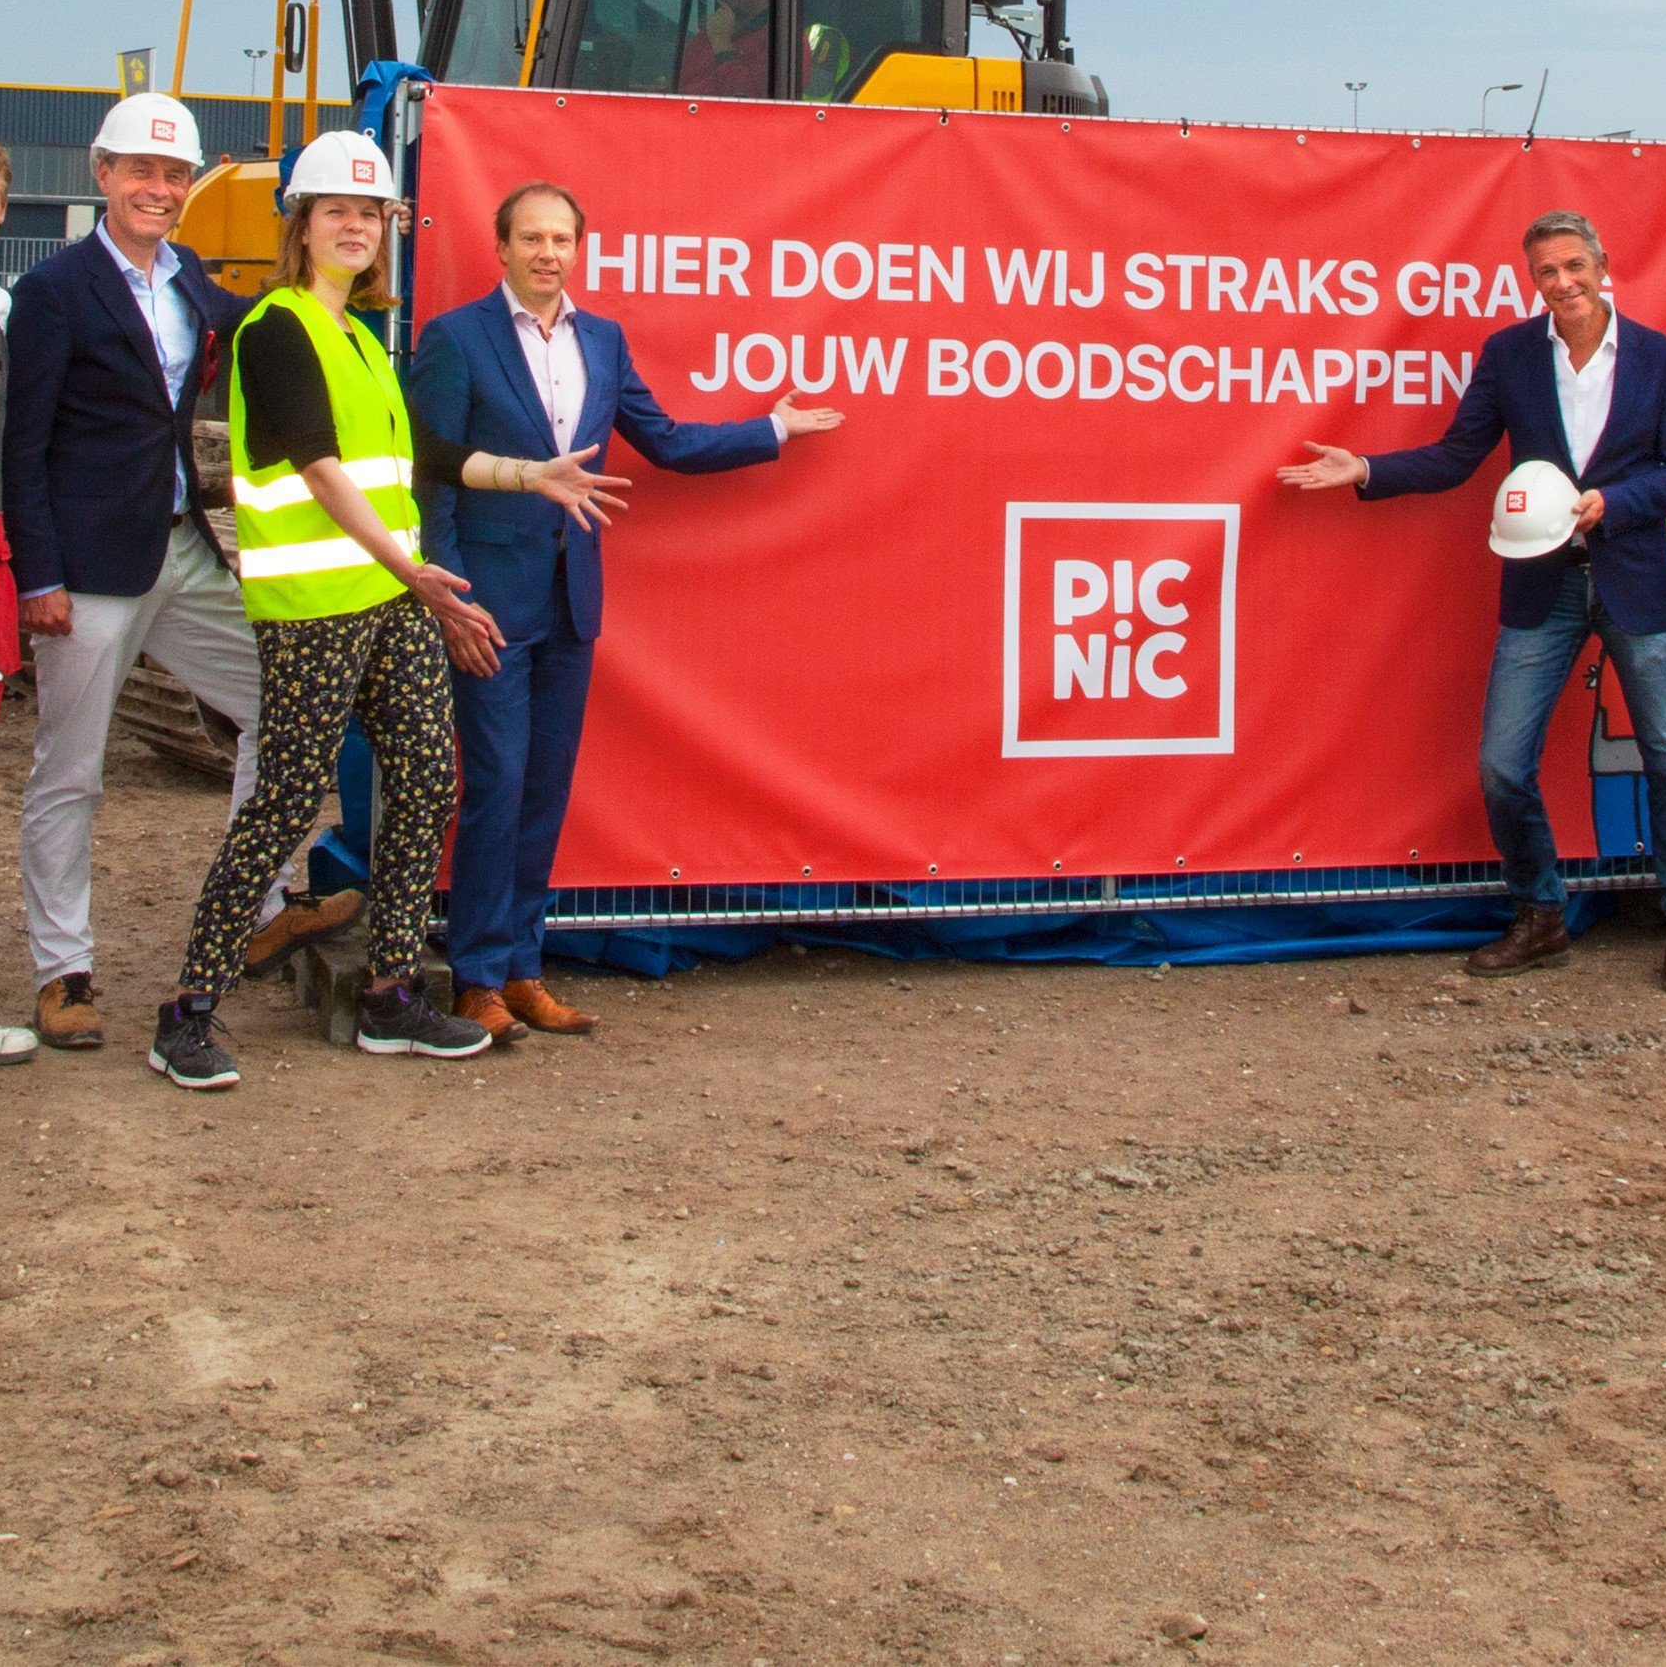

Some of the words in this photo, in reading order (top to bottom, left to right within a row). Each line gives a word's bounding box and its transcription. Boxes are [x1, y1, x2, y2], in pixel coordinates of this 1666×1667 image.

[586, 232, 751, 297] HIER
[771, 239, 965, 304] DOEN
[984, 246, 1105, 309] WIJ
[1123, 252, 1380, 318] STRAKS
[690, 332, 909, 396] JOUW
[927, 338, 1473, 405] BOODSCHAPPEN
[1053, 558, 1192, 626] PIC
